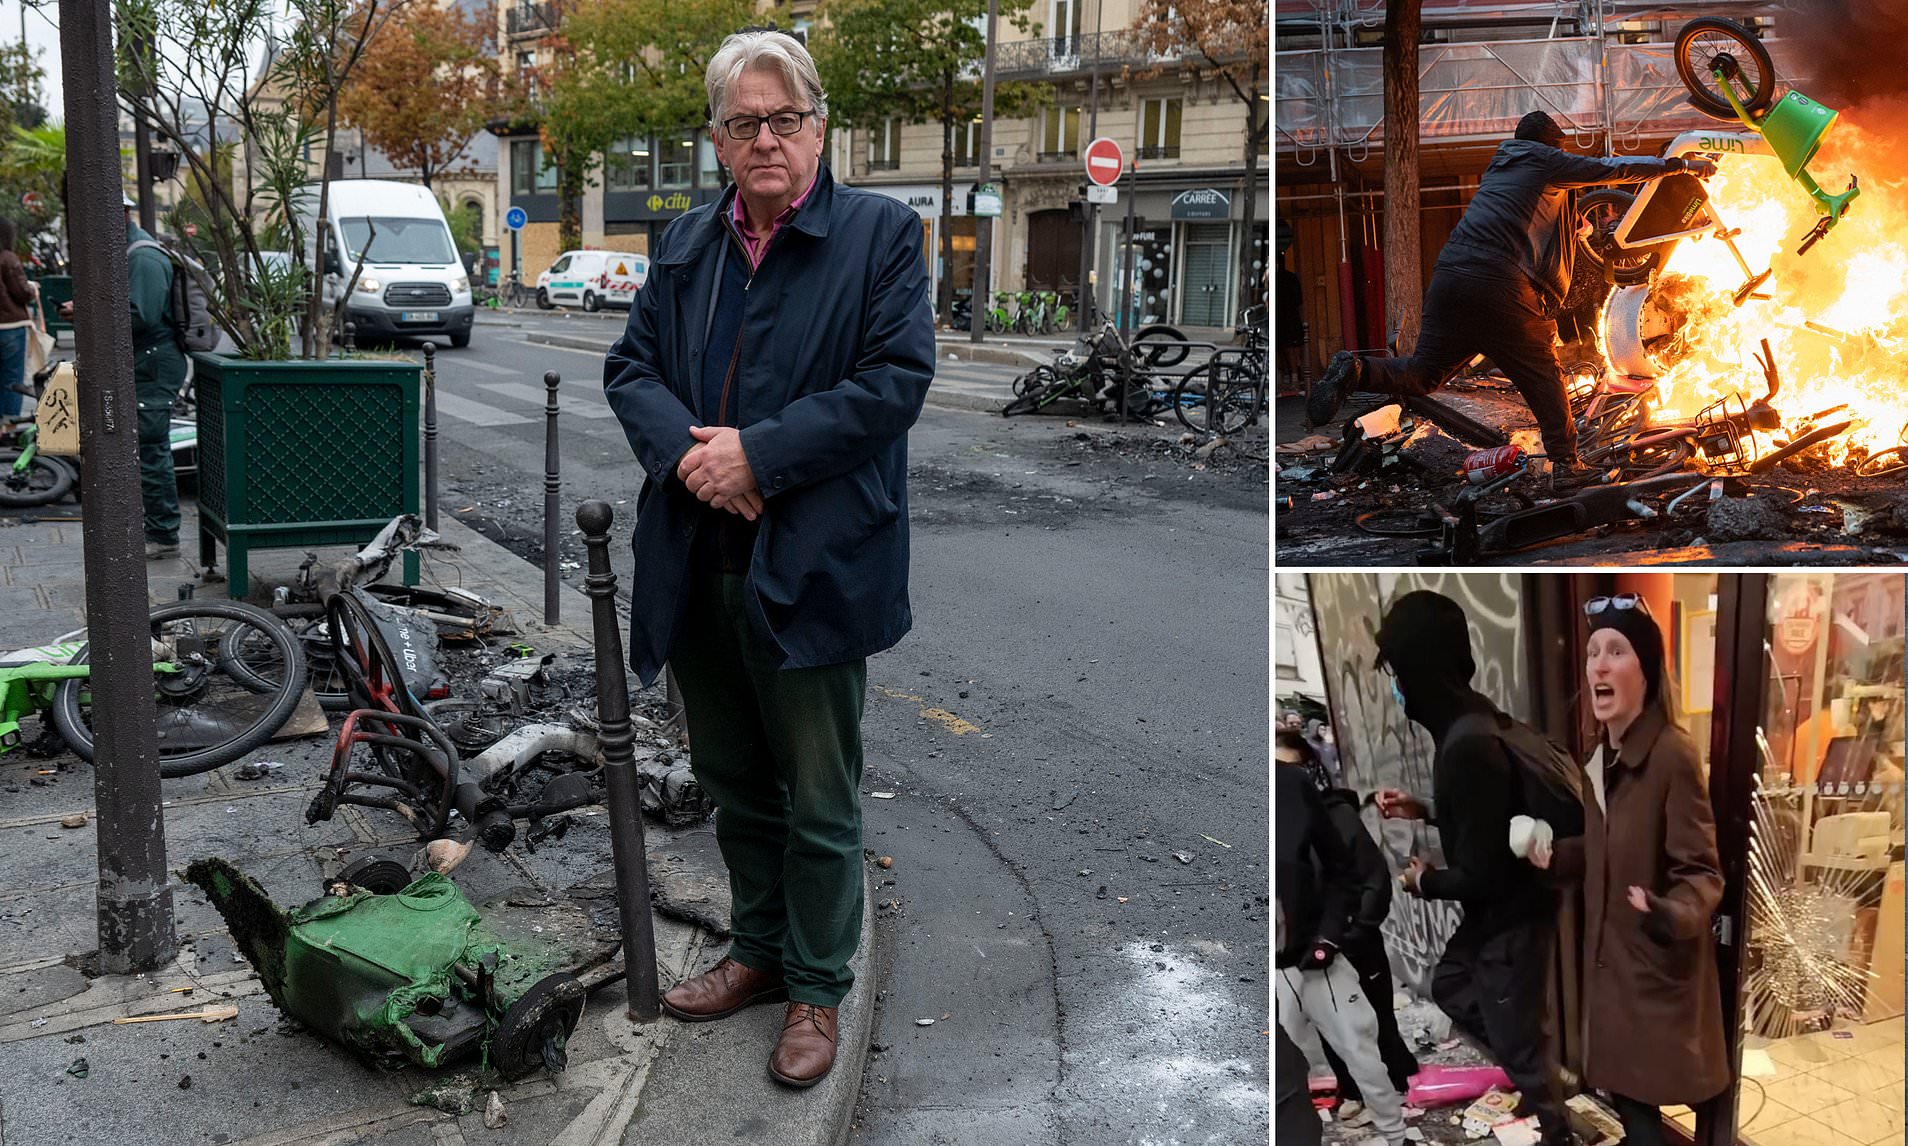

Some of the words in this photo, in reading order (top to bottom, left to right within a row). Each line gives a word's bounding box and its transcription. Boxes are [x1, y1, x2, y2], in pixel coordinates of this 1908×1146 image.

[1699, 137, 1744, 154] Lime
[665, 192, 691, 213] city
[908, 196, 934, 207] AURA
[403, 649, 417, 672] Uber
